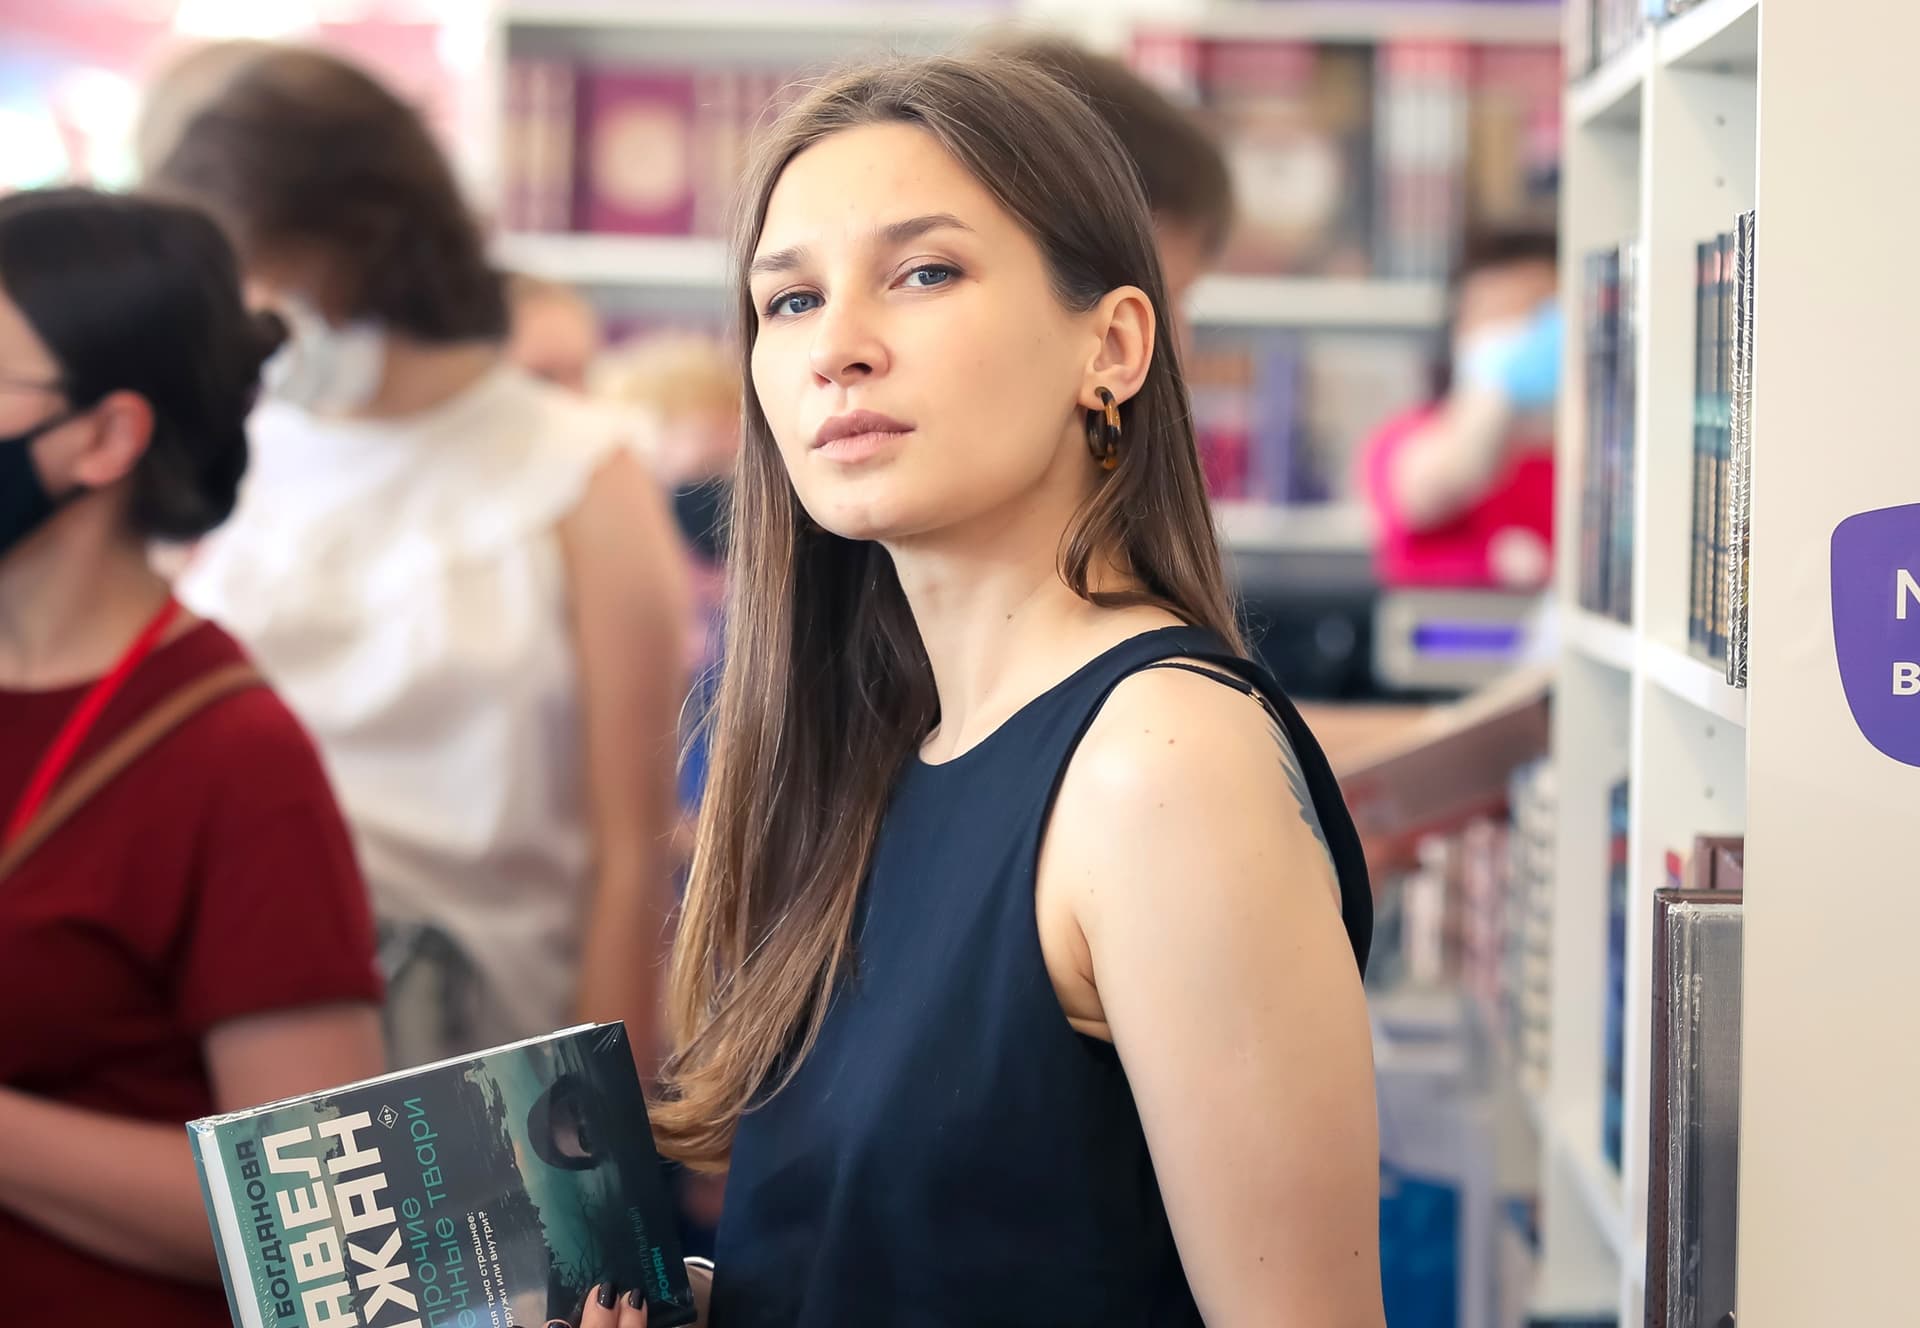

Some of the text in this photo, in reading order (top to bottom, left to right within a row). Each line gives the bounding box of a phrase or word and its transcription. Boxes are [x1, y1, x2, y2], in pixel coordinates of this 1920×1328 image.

[383, 1108, 393, 1125] 18+
[403, 1098, 447, 1208] твари
[235, 1140, 296, 1318] БОГДАНОВА
[317, 1111, 425, 1328] ЖАН
[466, 1211, 488, 1277] страшнее:
[478, 1210, 498, 1261] внутри?
[402, 1197, 451, 1328] прочие
[492, 1263, 504, 1286] или
[650, 1247, 672, 1301] РОМАН
[483, 1279, 496, 1309] тьма
